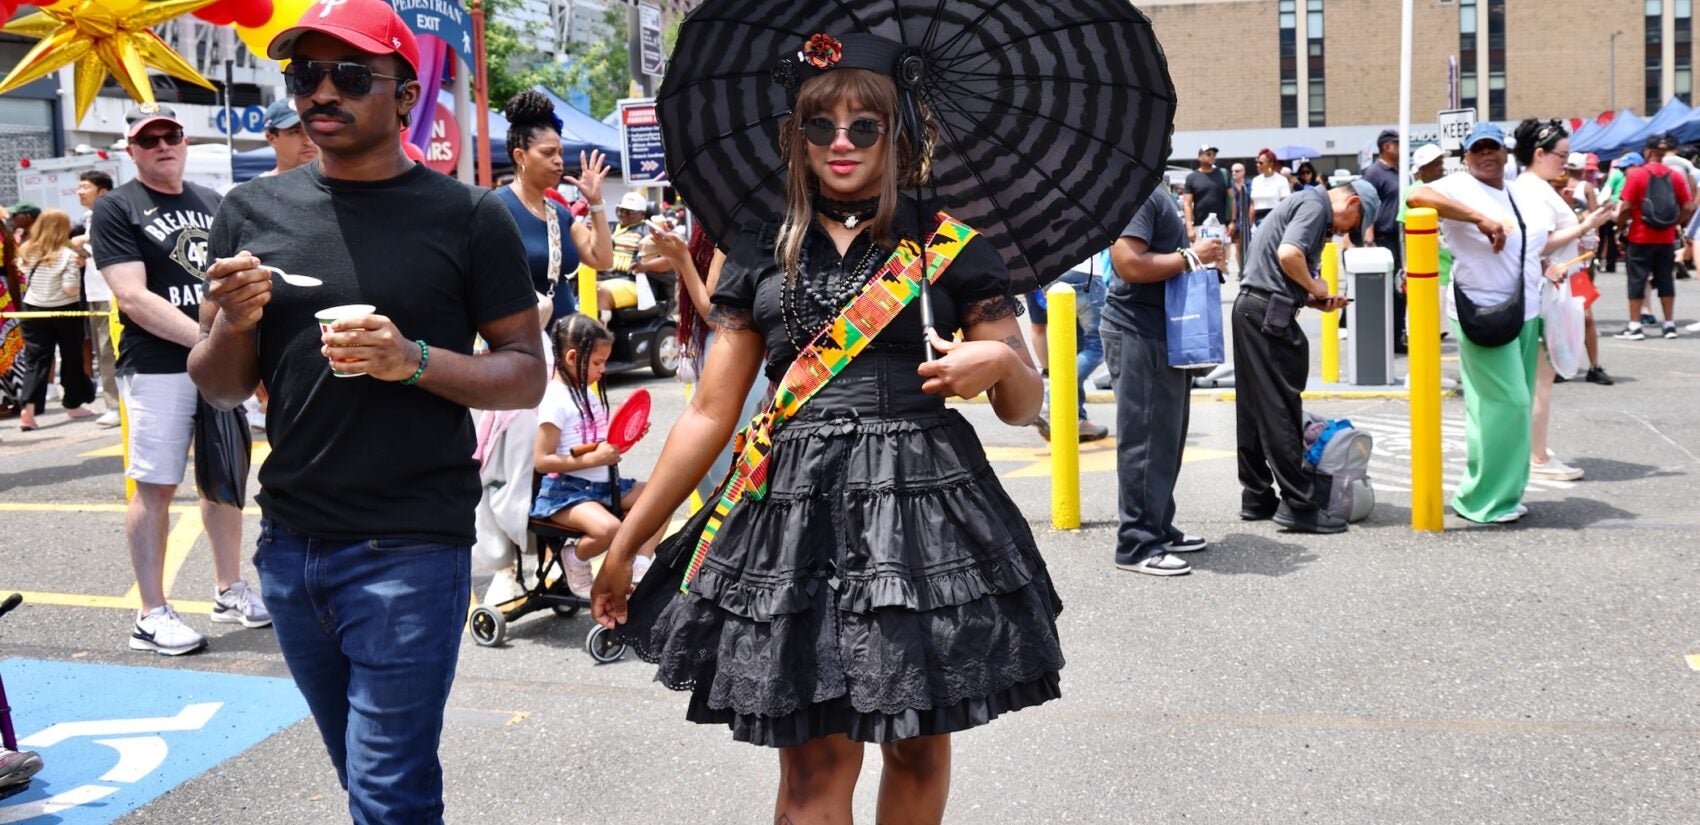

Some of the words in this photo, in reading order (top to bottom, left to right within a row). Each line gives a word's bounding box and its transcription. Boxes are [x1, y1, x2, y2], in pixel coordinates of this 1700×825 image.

[392, 0, 463, 25] PEDESTRIAN
[416, 13, 441, 31] EXIT
[1443, 122, 1470, 138] KEEP
[426, 141, 453, 162] IRS
[144, 210, 214, 242] BREAKIN
